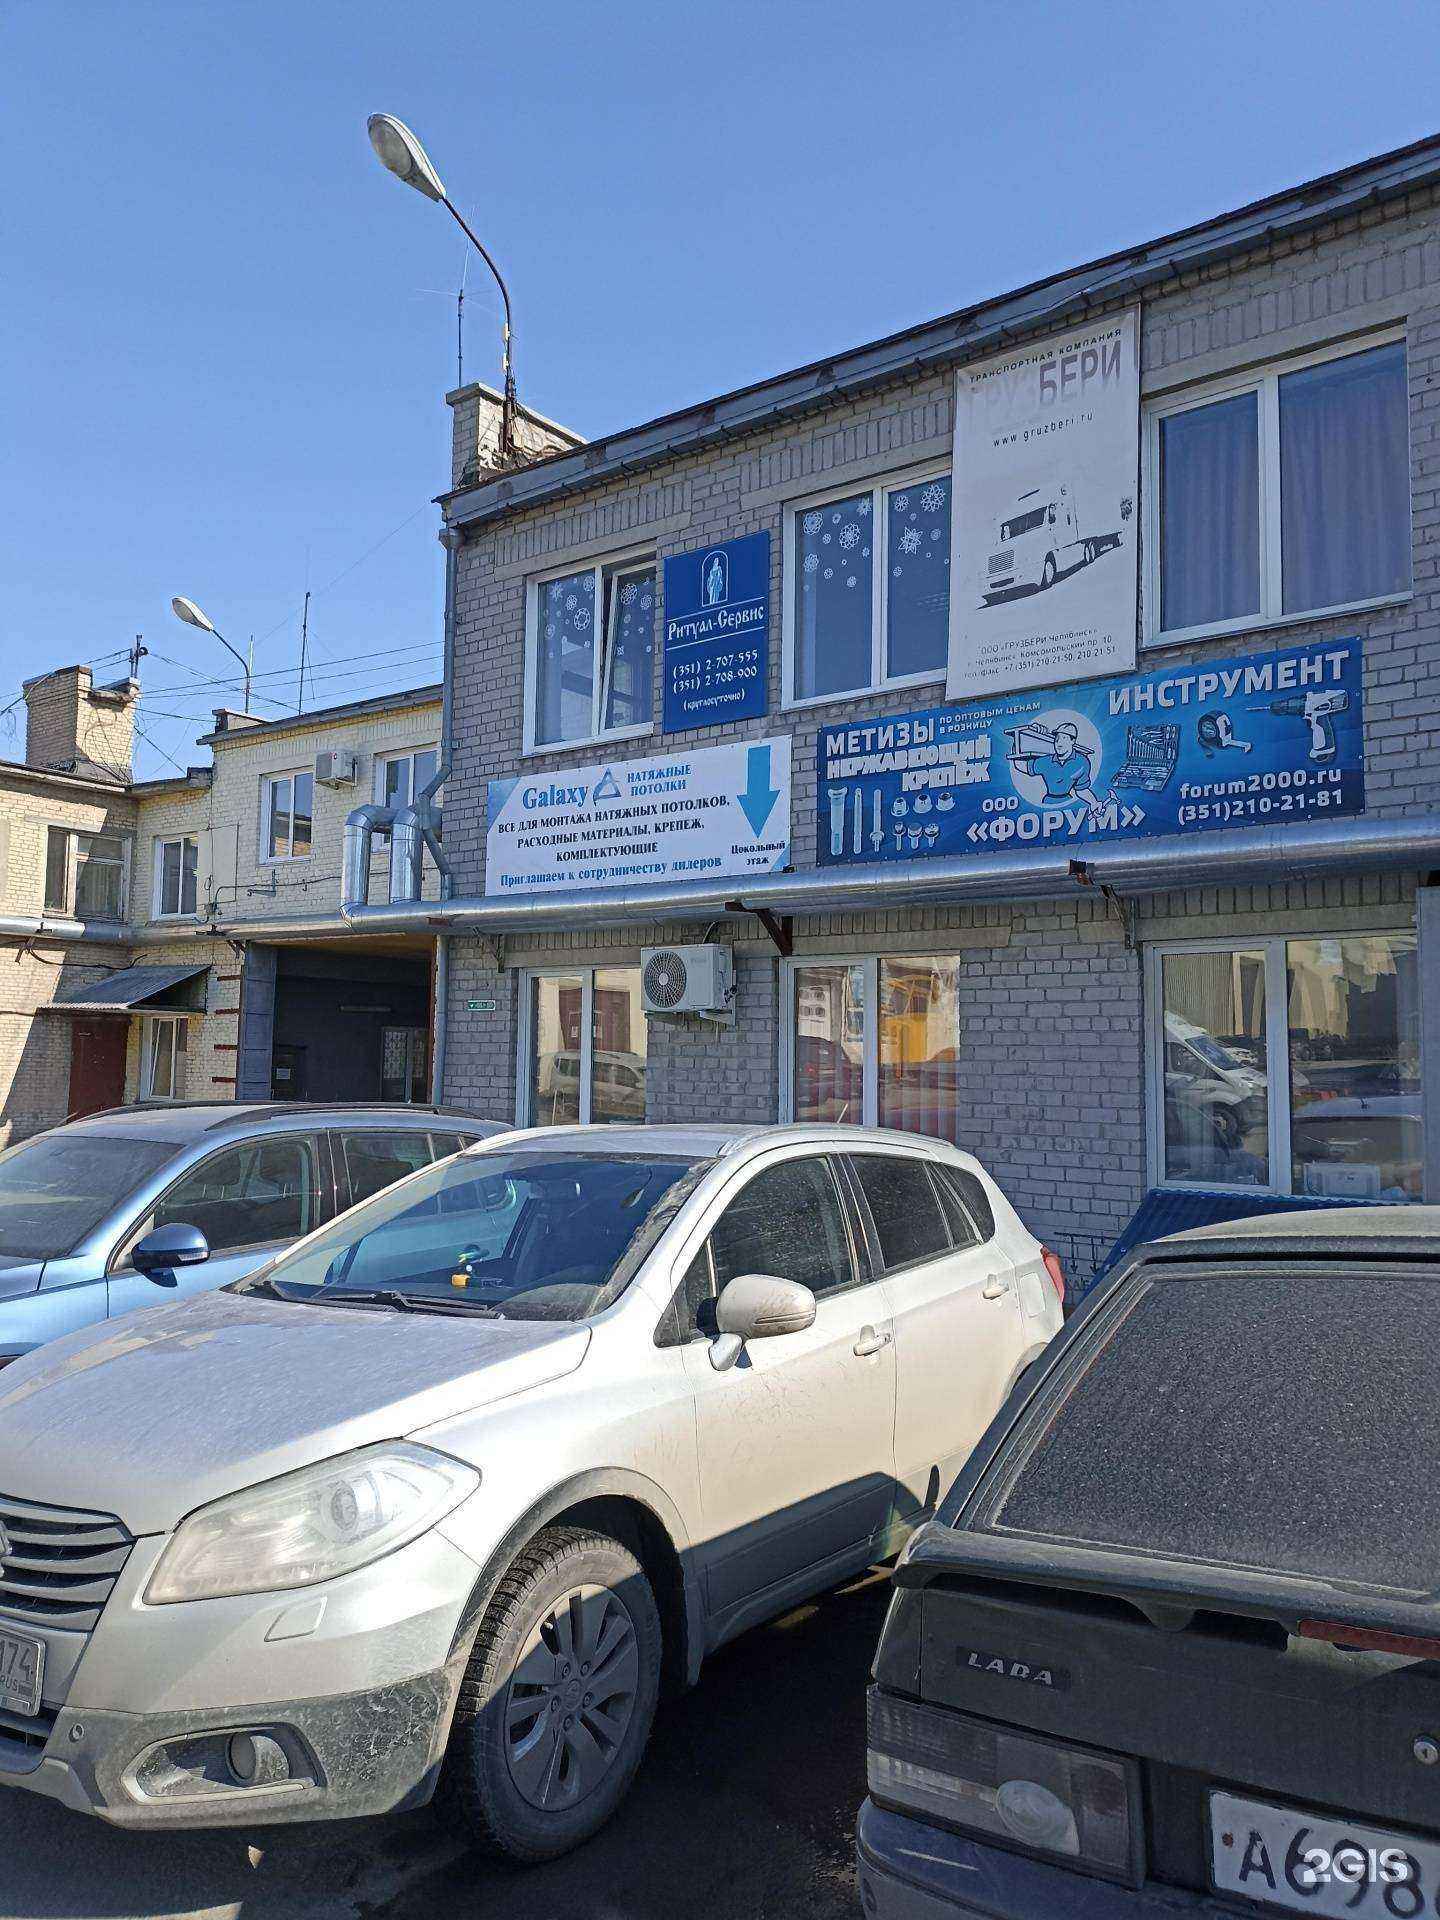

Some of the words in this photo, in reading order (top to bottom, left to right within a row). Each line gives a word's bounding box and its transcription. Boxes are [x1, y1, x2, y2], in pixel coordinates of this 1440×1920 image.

[970, 352, 1053, 383] ТРАНСПОРТНАЯ
[1059, 328, 1121, 357] КОМПАНИЯ
[667, 605, 764, 641] Ритуал-Сервис
[673, 660, 701, 679] (351)
[705, 649, 758, 670] 2-707-555
[673, 676, 701, 695] (351)
[705, 666, 758, 687] 2-708-900
[1109, 650, 1350, 716] ИНСТРУМЕНТ
[683, 688, 746, 712] (круглосуточно)
[939, 715, 952, 725] ПО
[954, 706, 1004, 723] ОПТОВЫМ
[1006, 701, 1041, 716] ЦЕНАМ
[826, 718, 934, 757] МЕТИЗЫ
[939, 726, 946, 735] В
[948, 719, 993, 734] РОЗНИЦУ
[627, 763, 692, 783] НАТЯЖНЫЕ
[1180, 767, 1342, 799] forum2000.ru
[522, 784, 589, 810] Galaxy
[631, 779, 687, 797] ПОТОЛКИ
[982, 795, 1019, 813] ООО
[1178, 788, 1343, 826] (351)210-21-81
[498, 822, 515, 834] ВСЕ
[517, 819, 538, 832] ДЛЯ
[541, 812, 592, 829] МОНТАЖА
[595, 804, 658, 822] НАТЯЖНЫХ
[517, 832, 579, 849] РАСХОДНЫЕ
[581, 824, 652, 842] МАТЕРИАЛЫ,
[731, 840, 786, 855] Цокольный
[556, 842, 659, 862] КОМПЛЕКТУЮЩИЕ
[746, 856, 770, 866] этаж
[501, 871, 565, 888] Приглашаем
[568, 871, 576, 881] к
[578, 861, 667, 881] сотрудничеству
[672, 856, 722, 872] дилеров
[968, 1652, 1053, 1685] LADA
[1239, 1827, 1440, 1919] А698
